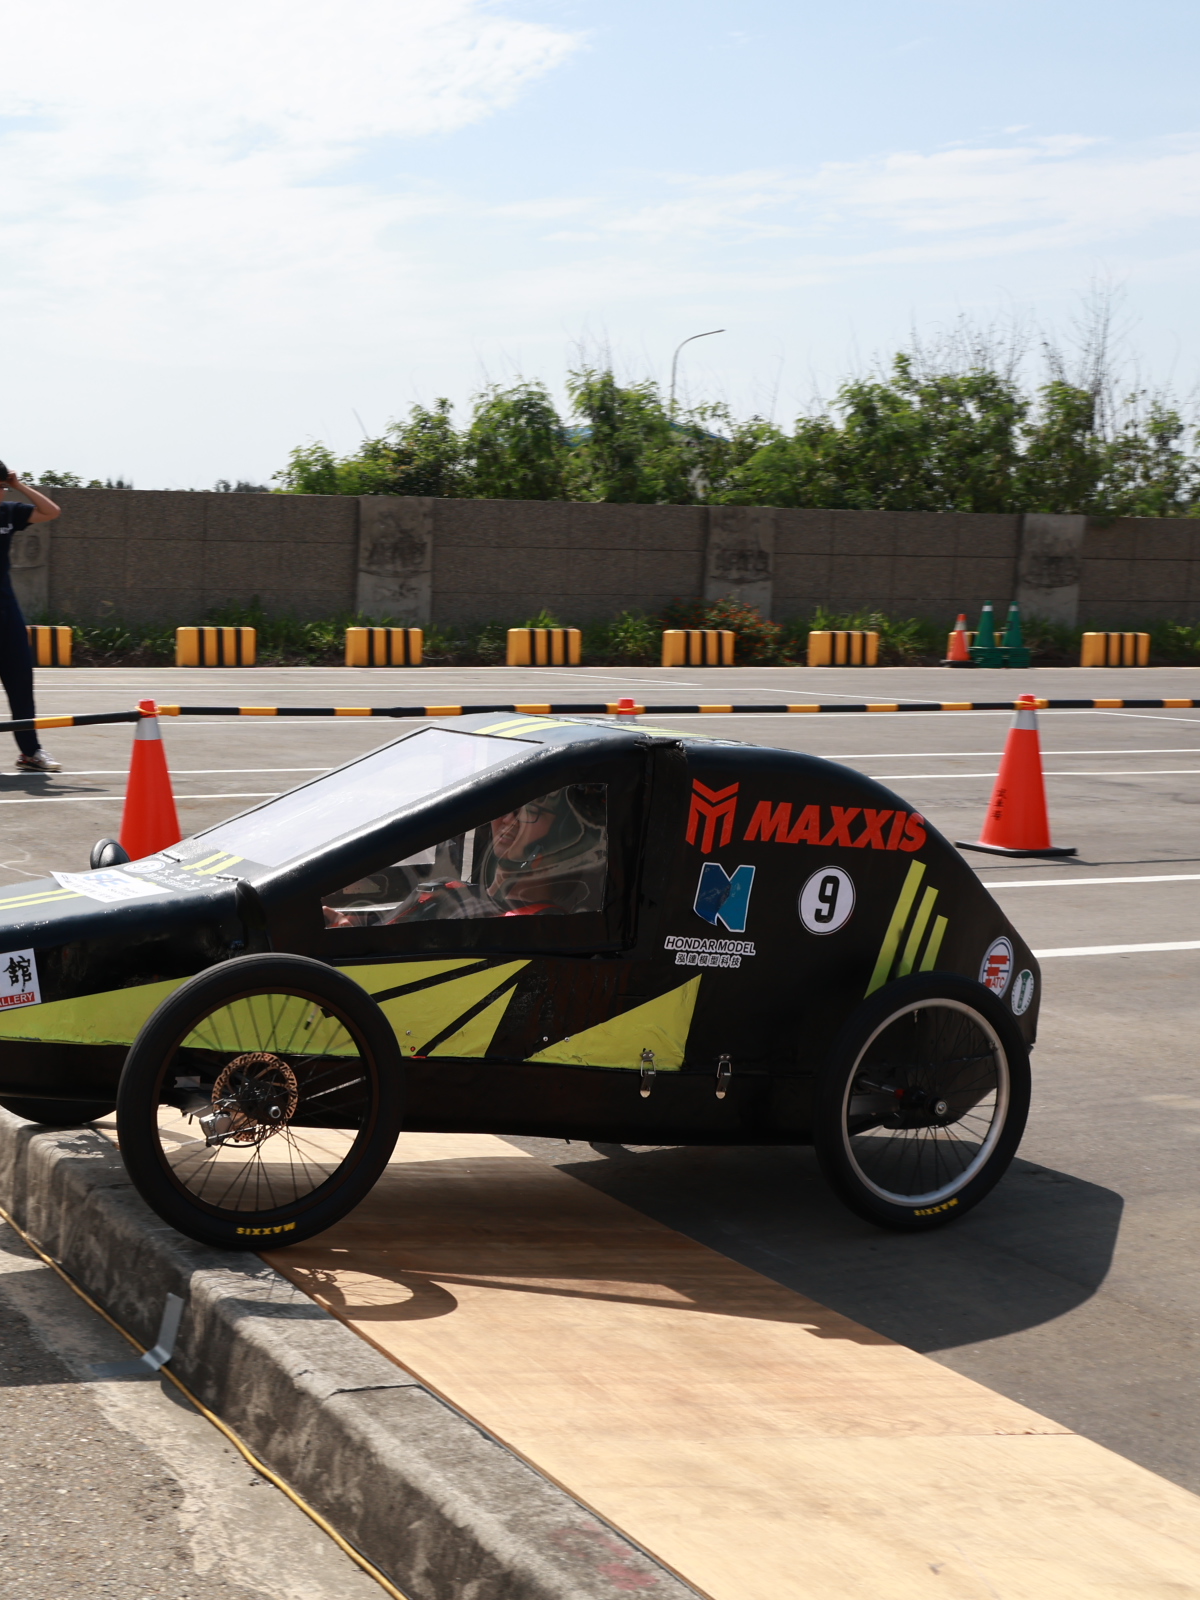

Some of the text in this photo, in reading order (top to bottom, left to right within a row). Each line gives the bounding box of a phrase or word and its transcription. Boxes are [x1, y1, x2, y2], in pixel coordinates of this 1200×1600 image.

[743, 800, 927, 852] MAXXIS
[814, 875, 840, 924] 9
[665, 937, 756, 954] HONDAR MODEL
[235, 1221, 296, 1236] MAXXIS
